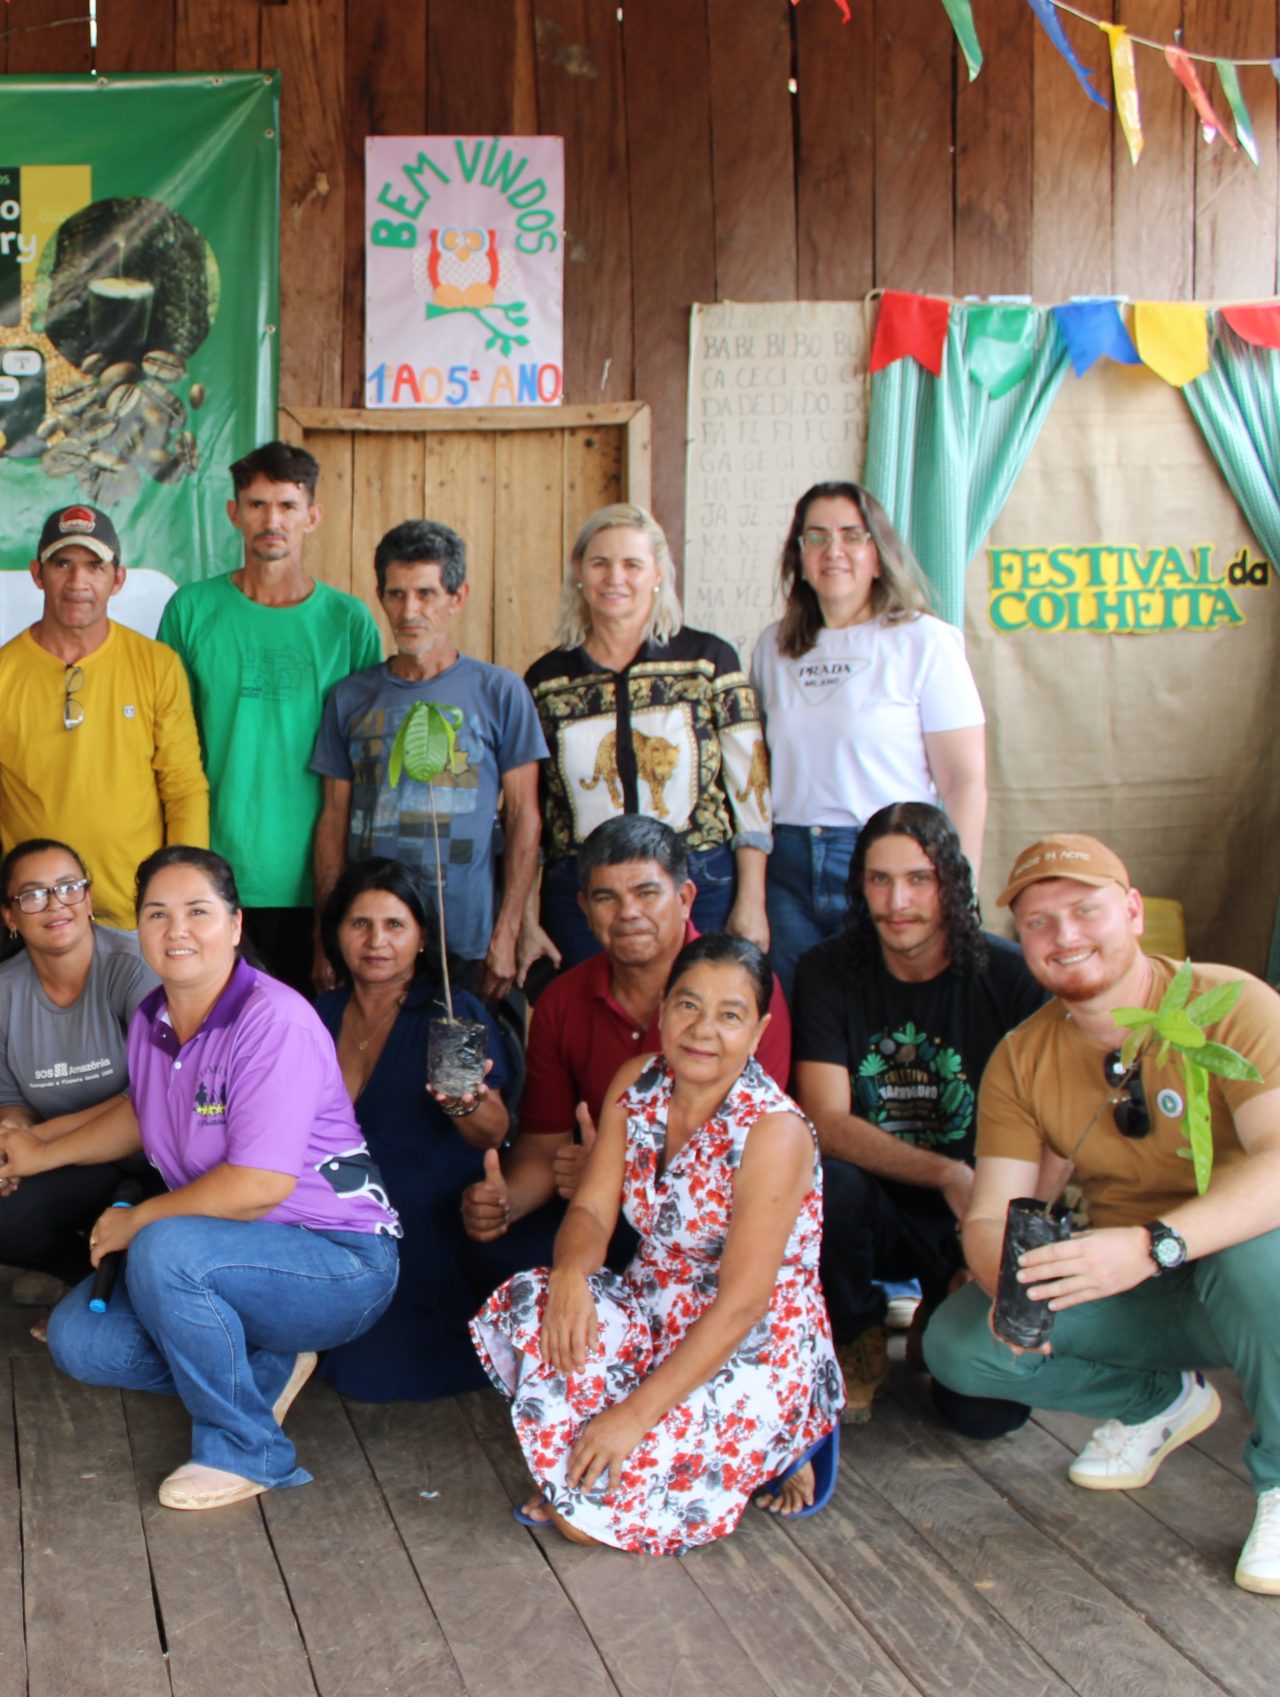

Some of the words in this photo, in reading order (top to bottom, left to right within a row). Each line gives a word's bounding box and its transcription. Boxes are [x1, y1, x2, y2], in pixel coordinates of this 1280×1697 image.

[371, 151, 450, 249] BEM
[455, 136, 558, 255] VINDOS
[490, 362, 562, 404] ANO
[989, 546, 1226, 590] FESTIVAL
[1228, 550, 1269, 586] da
[989, 588, 1244, 631] COLHEITA
[798, 664, 851, 677] PRADA
[34, 1069, 54, 1079] SOS
[69, 1058, 111, 1075] Amazônia
